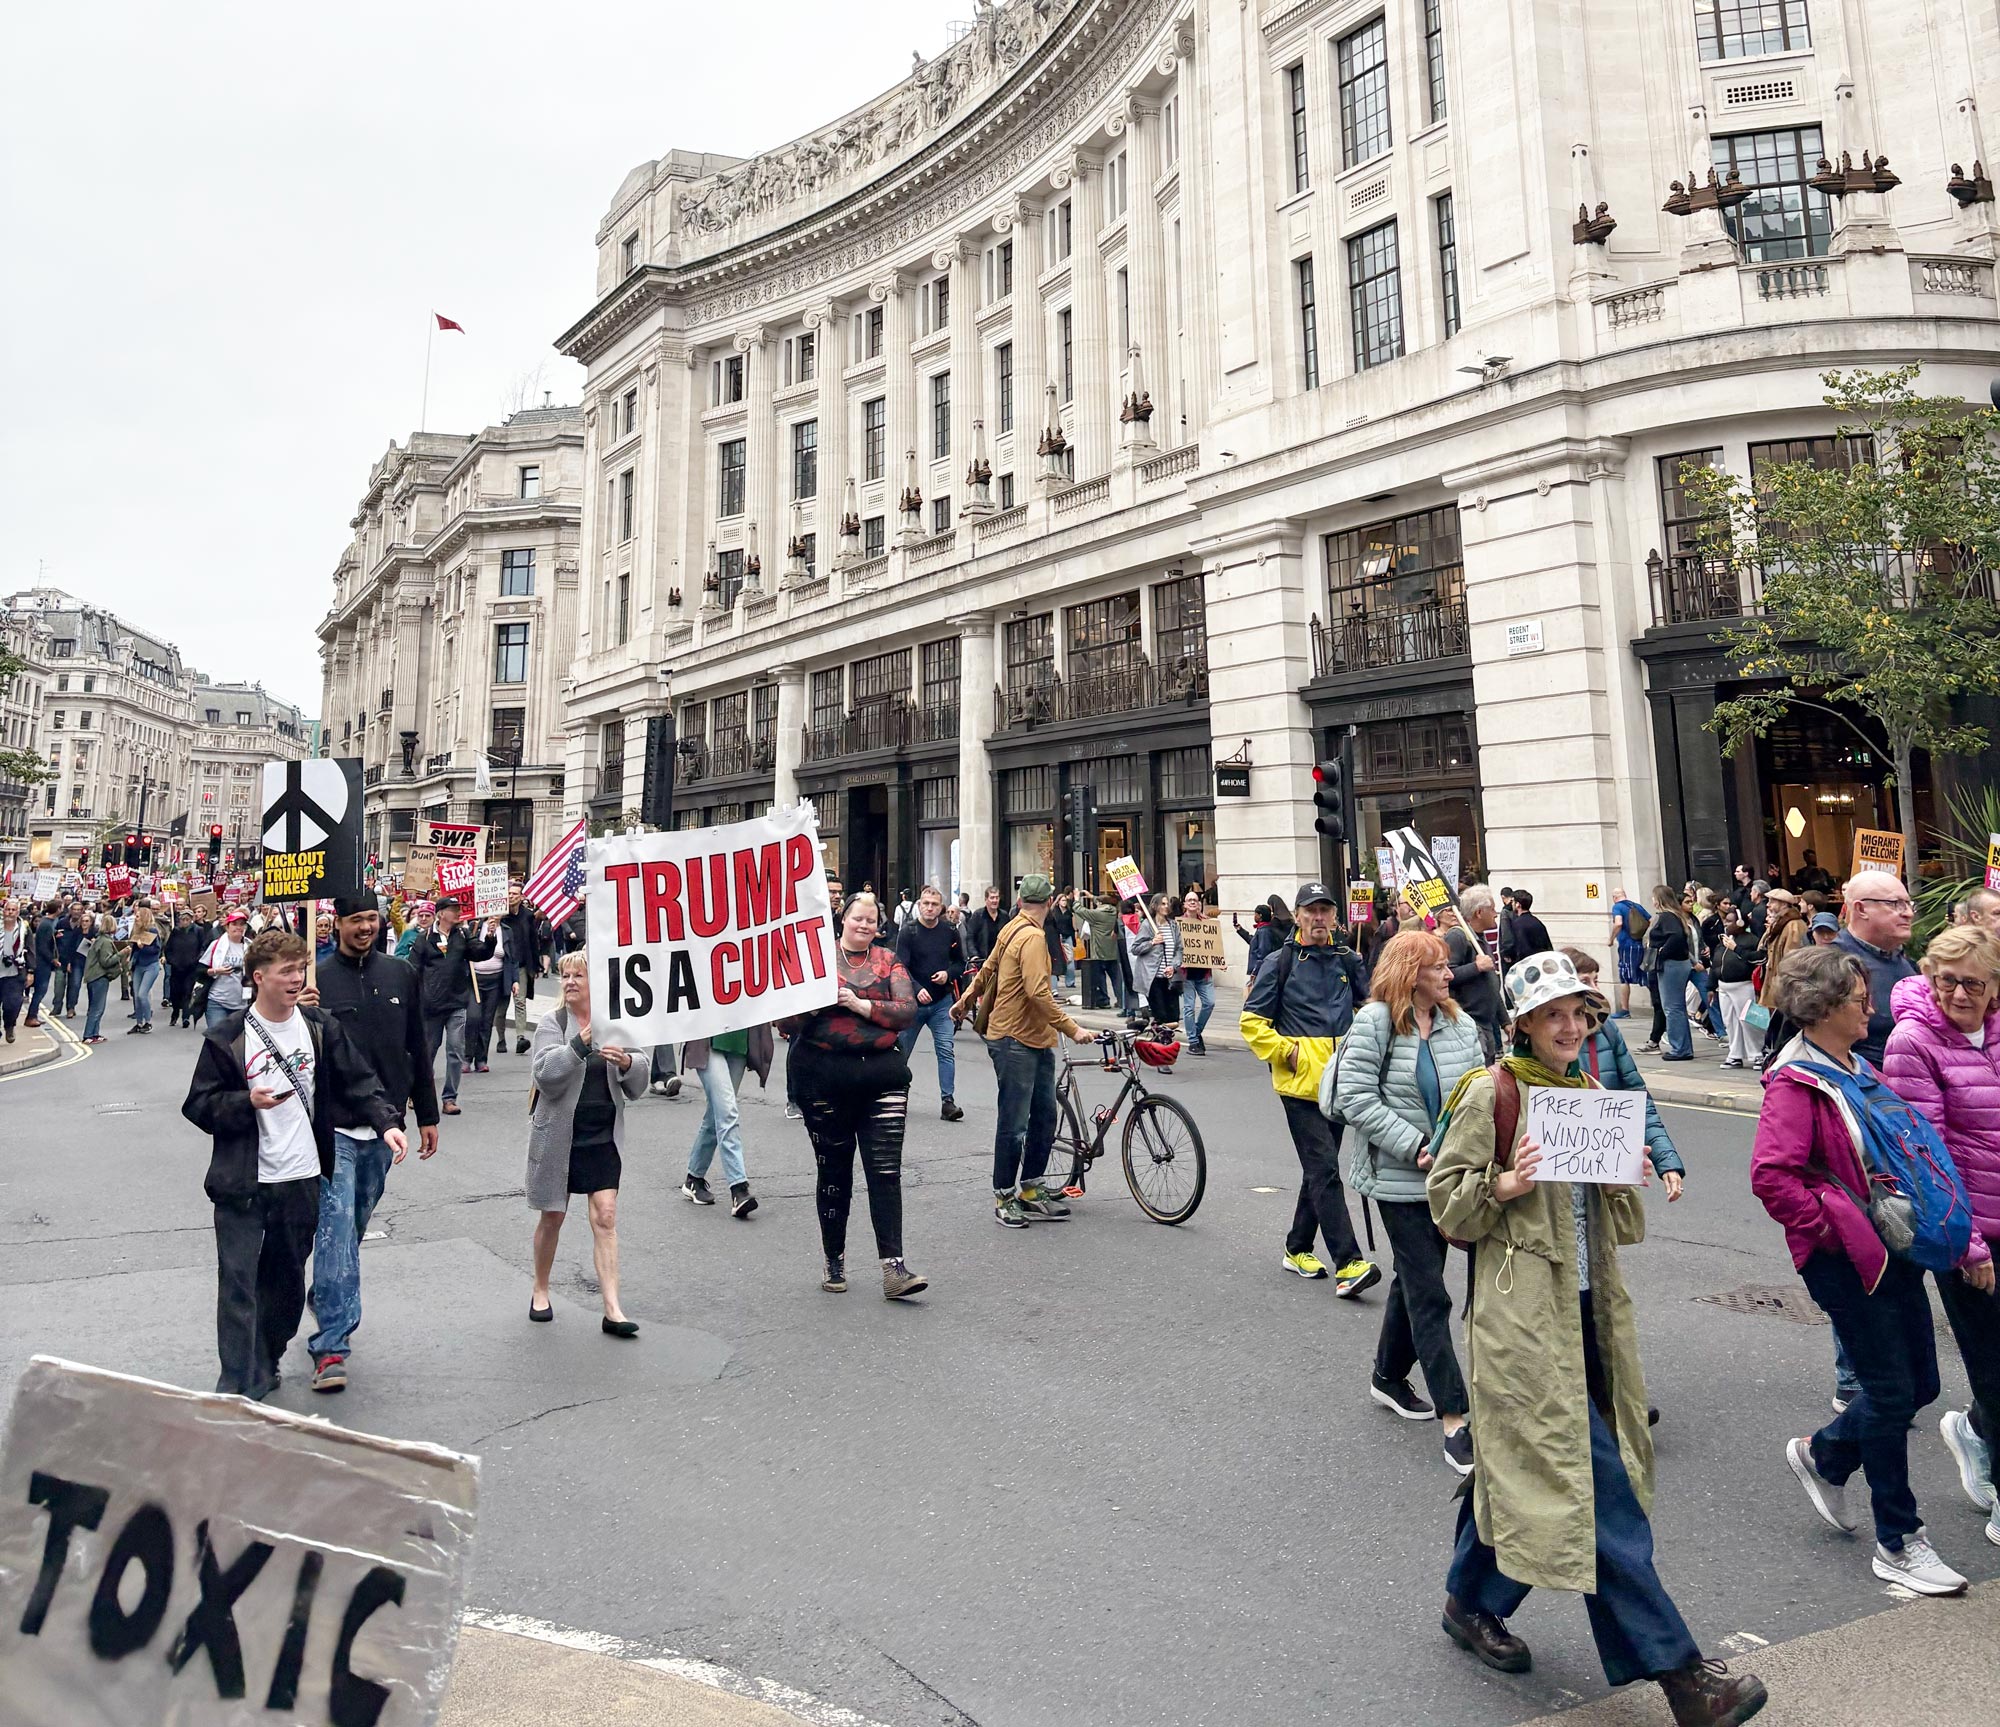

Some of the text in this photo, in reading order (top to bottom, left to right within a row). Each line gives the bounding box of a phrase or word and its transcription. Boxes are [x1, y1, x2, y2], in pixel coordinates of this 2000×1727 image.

[1508, 625, 1529, 636] REGENT
[1509, 634, 1529, 645] STREET
[1861, 834, 1900, 849] MIGRANTS
[265, 850, 326, 869] KICK OUT
[1860, 845, 1899, 860] WELCOME
[264, 865, 325, 882] TRUMP'S
[441, 862, 474, 882] STOP
[264, 880, 310, 896] NUKES
[443, 875, 474, 892] TRUMP
[604, 833, 815, 948] TRUMP
[1177, 920, 1218, 935] TRUMP CAN
[1183, 938, 1215, 950] KISS MY
[1182, 953, 1226, 966] GREASY RING
[608, 916, 827, 1021] IS A CUNT
[1531, 1089, 1634, 1119] FREE THE
[1542, 1121, 1631, 1156] WINDSOR
[20, 1471, 406, 1727] TOXIC
